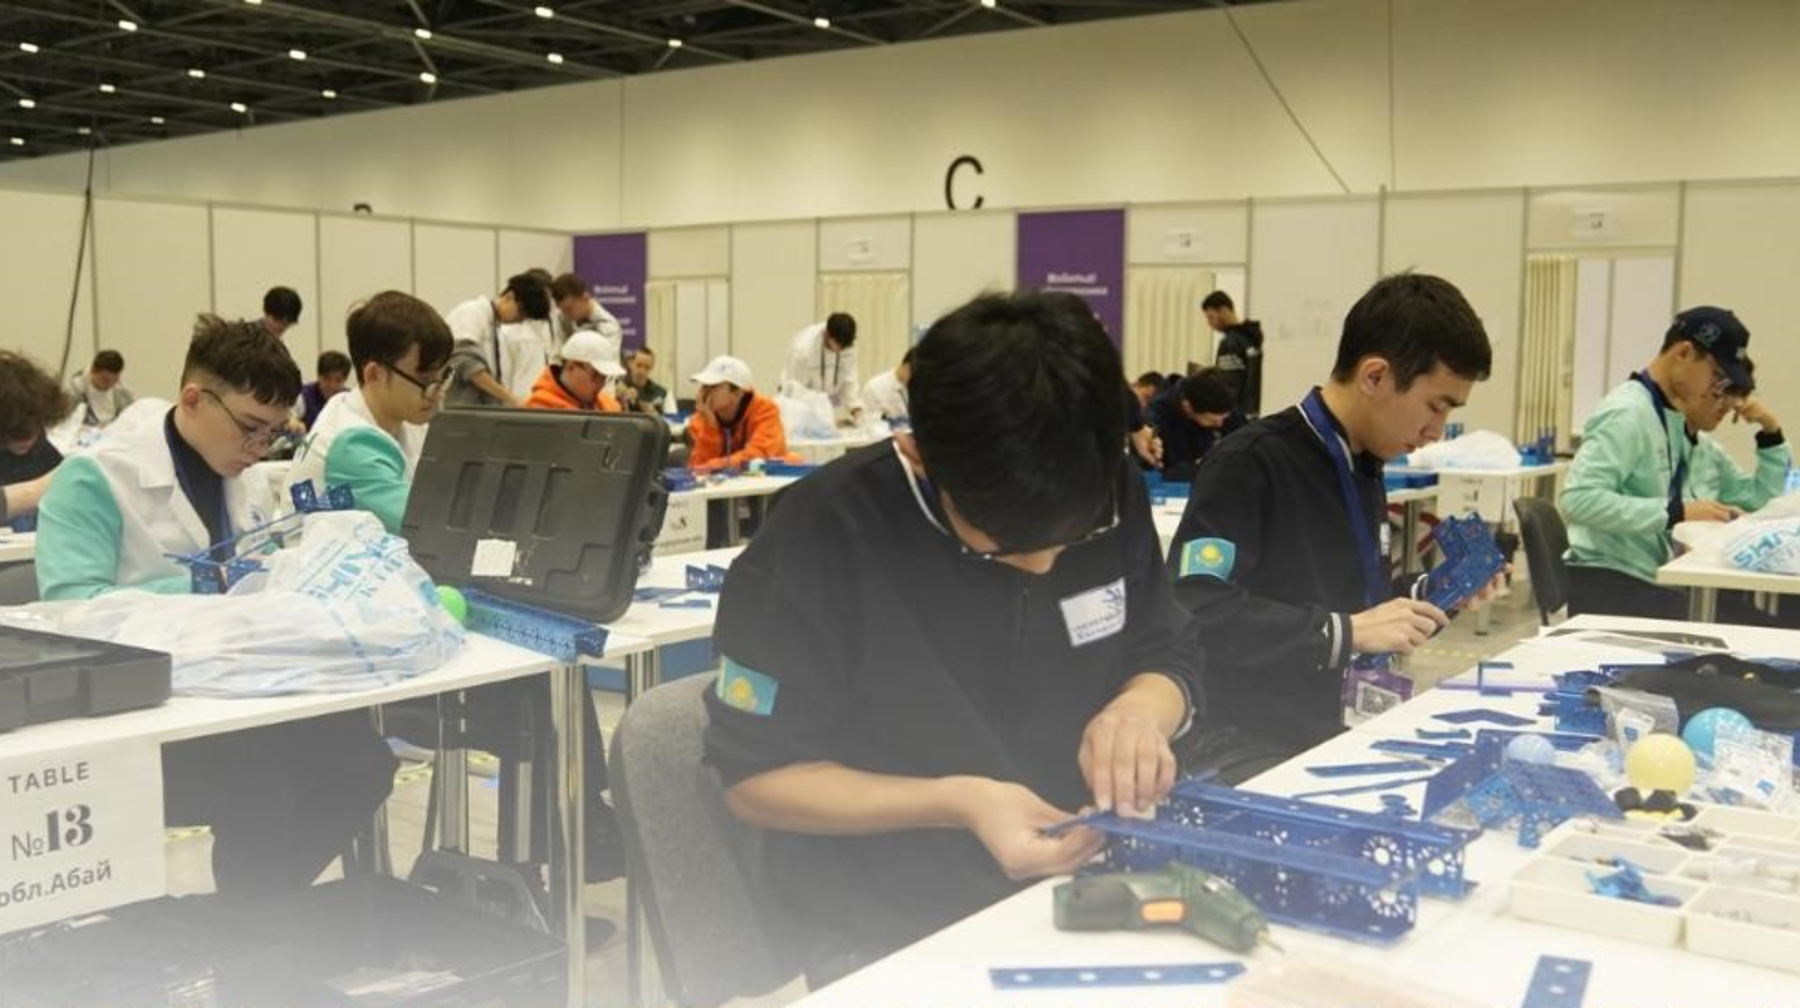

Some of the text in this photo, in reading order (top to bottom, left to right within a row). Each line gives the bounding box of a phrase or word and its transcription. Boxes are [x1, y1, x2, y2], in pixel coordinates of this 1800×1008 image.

[945, 155, 984, 211] C
[7, 761, 90, 794] TABLE
[11, 804, 93, 861] №13
[0, 859, 112, 908] обл.Абай
